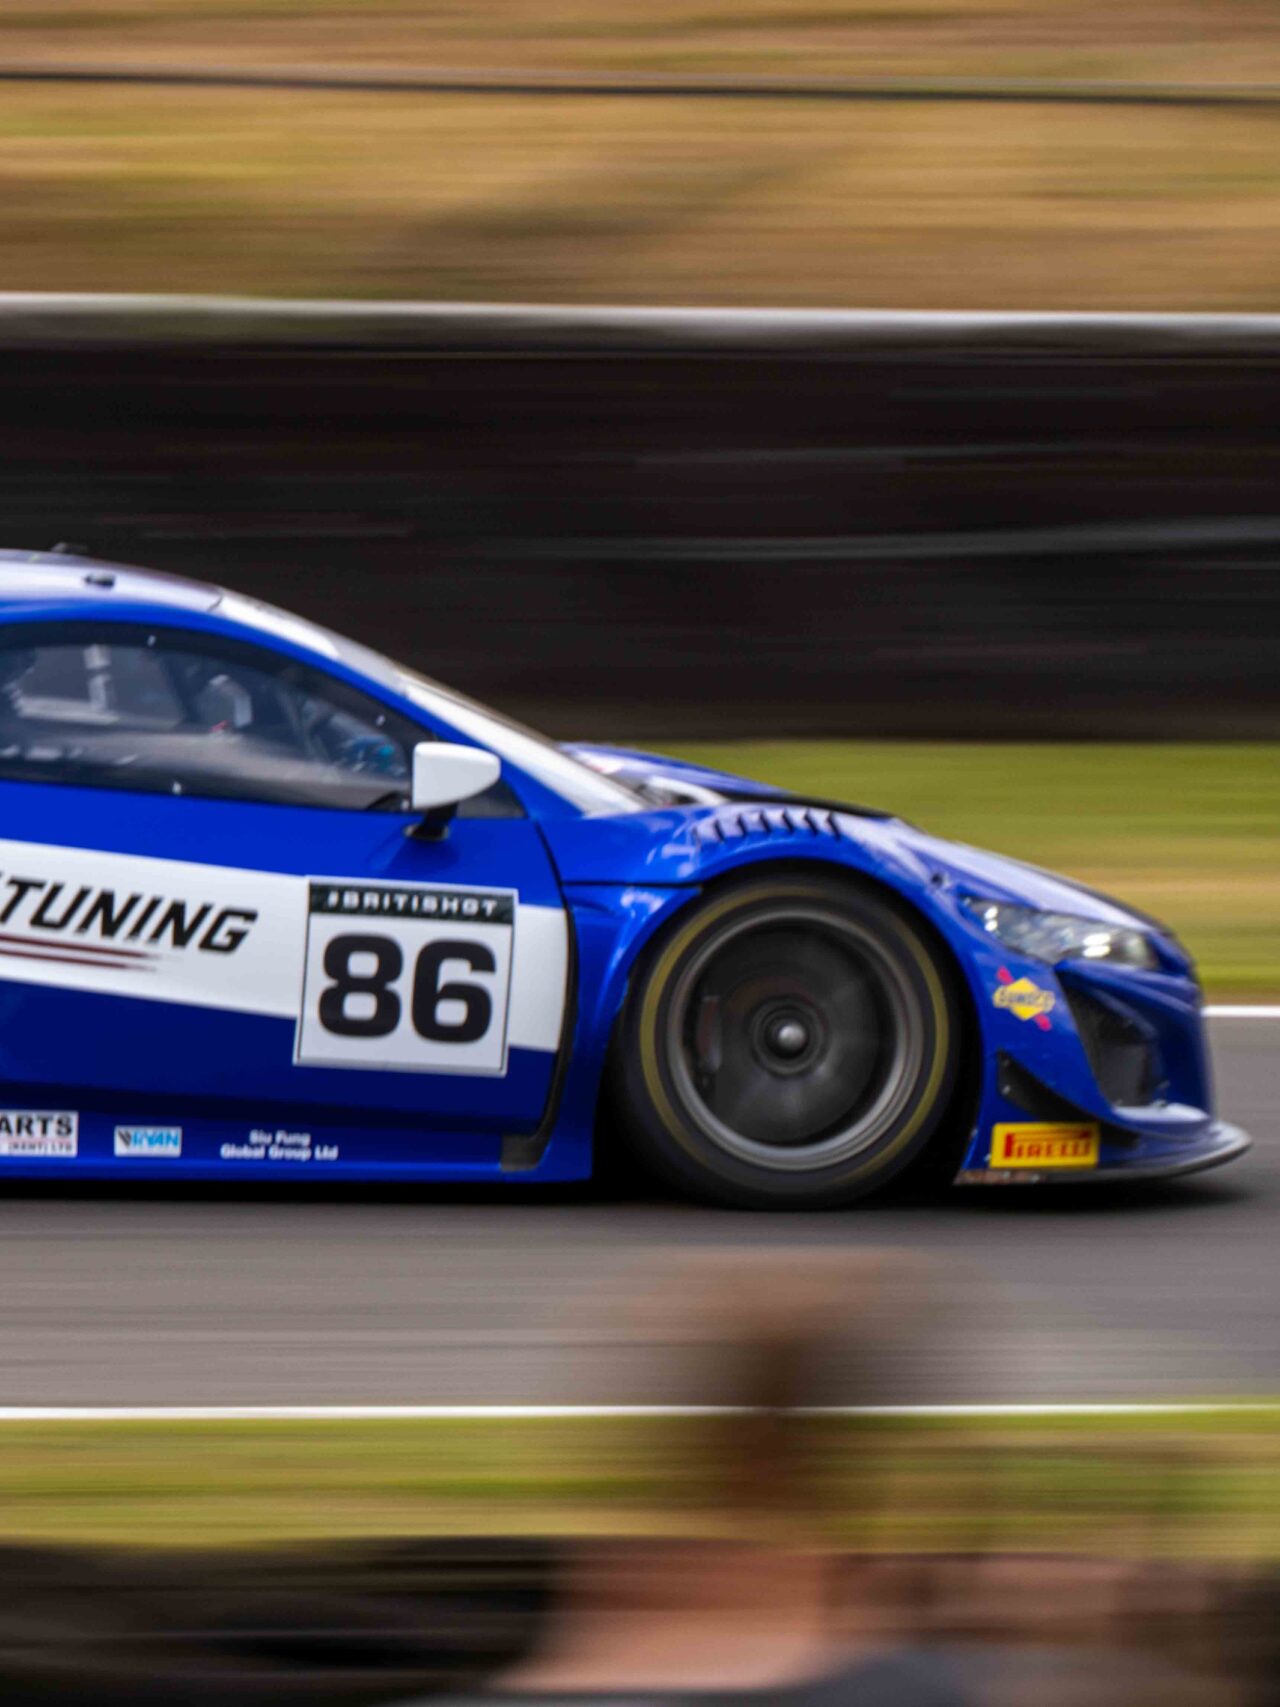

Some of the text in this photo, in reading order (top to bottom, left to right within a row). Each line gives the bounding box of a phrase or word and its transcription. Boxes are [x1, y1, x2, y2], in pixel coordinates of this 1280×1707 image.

[318, 932, 498, 1044] 86
[221, 1144, 339, 1162] Global Group Ltd
[1003, 1128, 1093, 1158] PIRELLI
